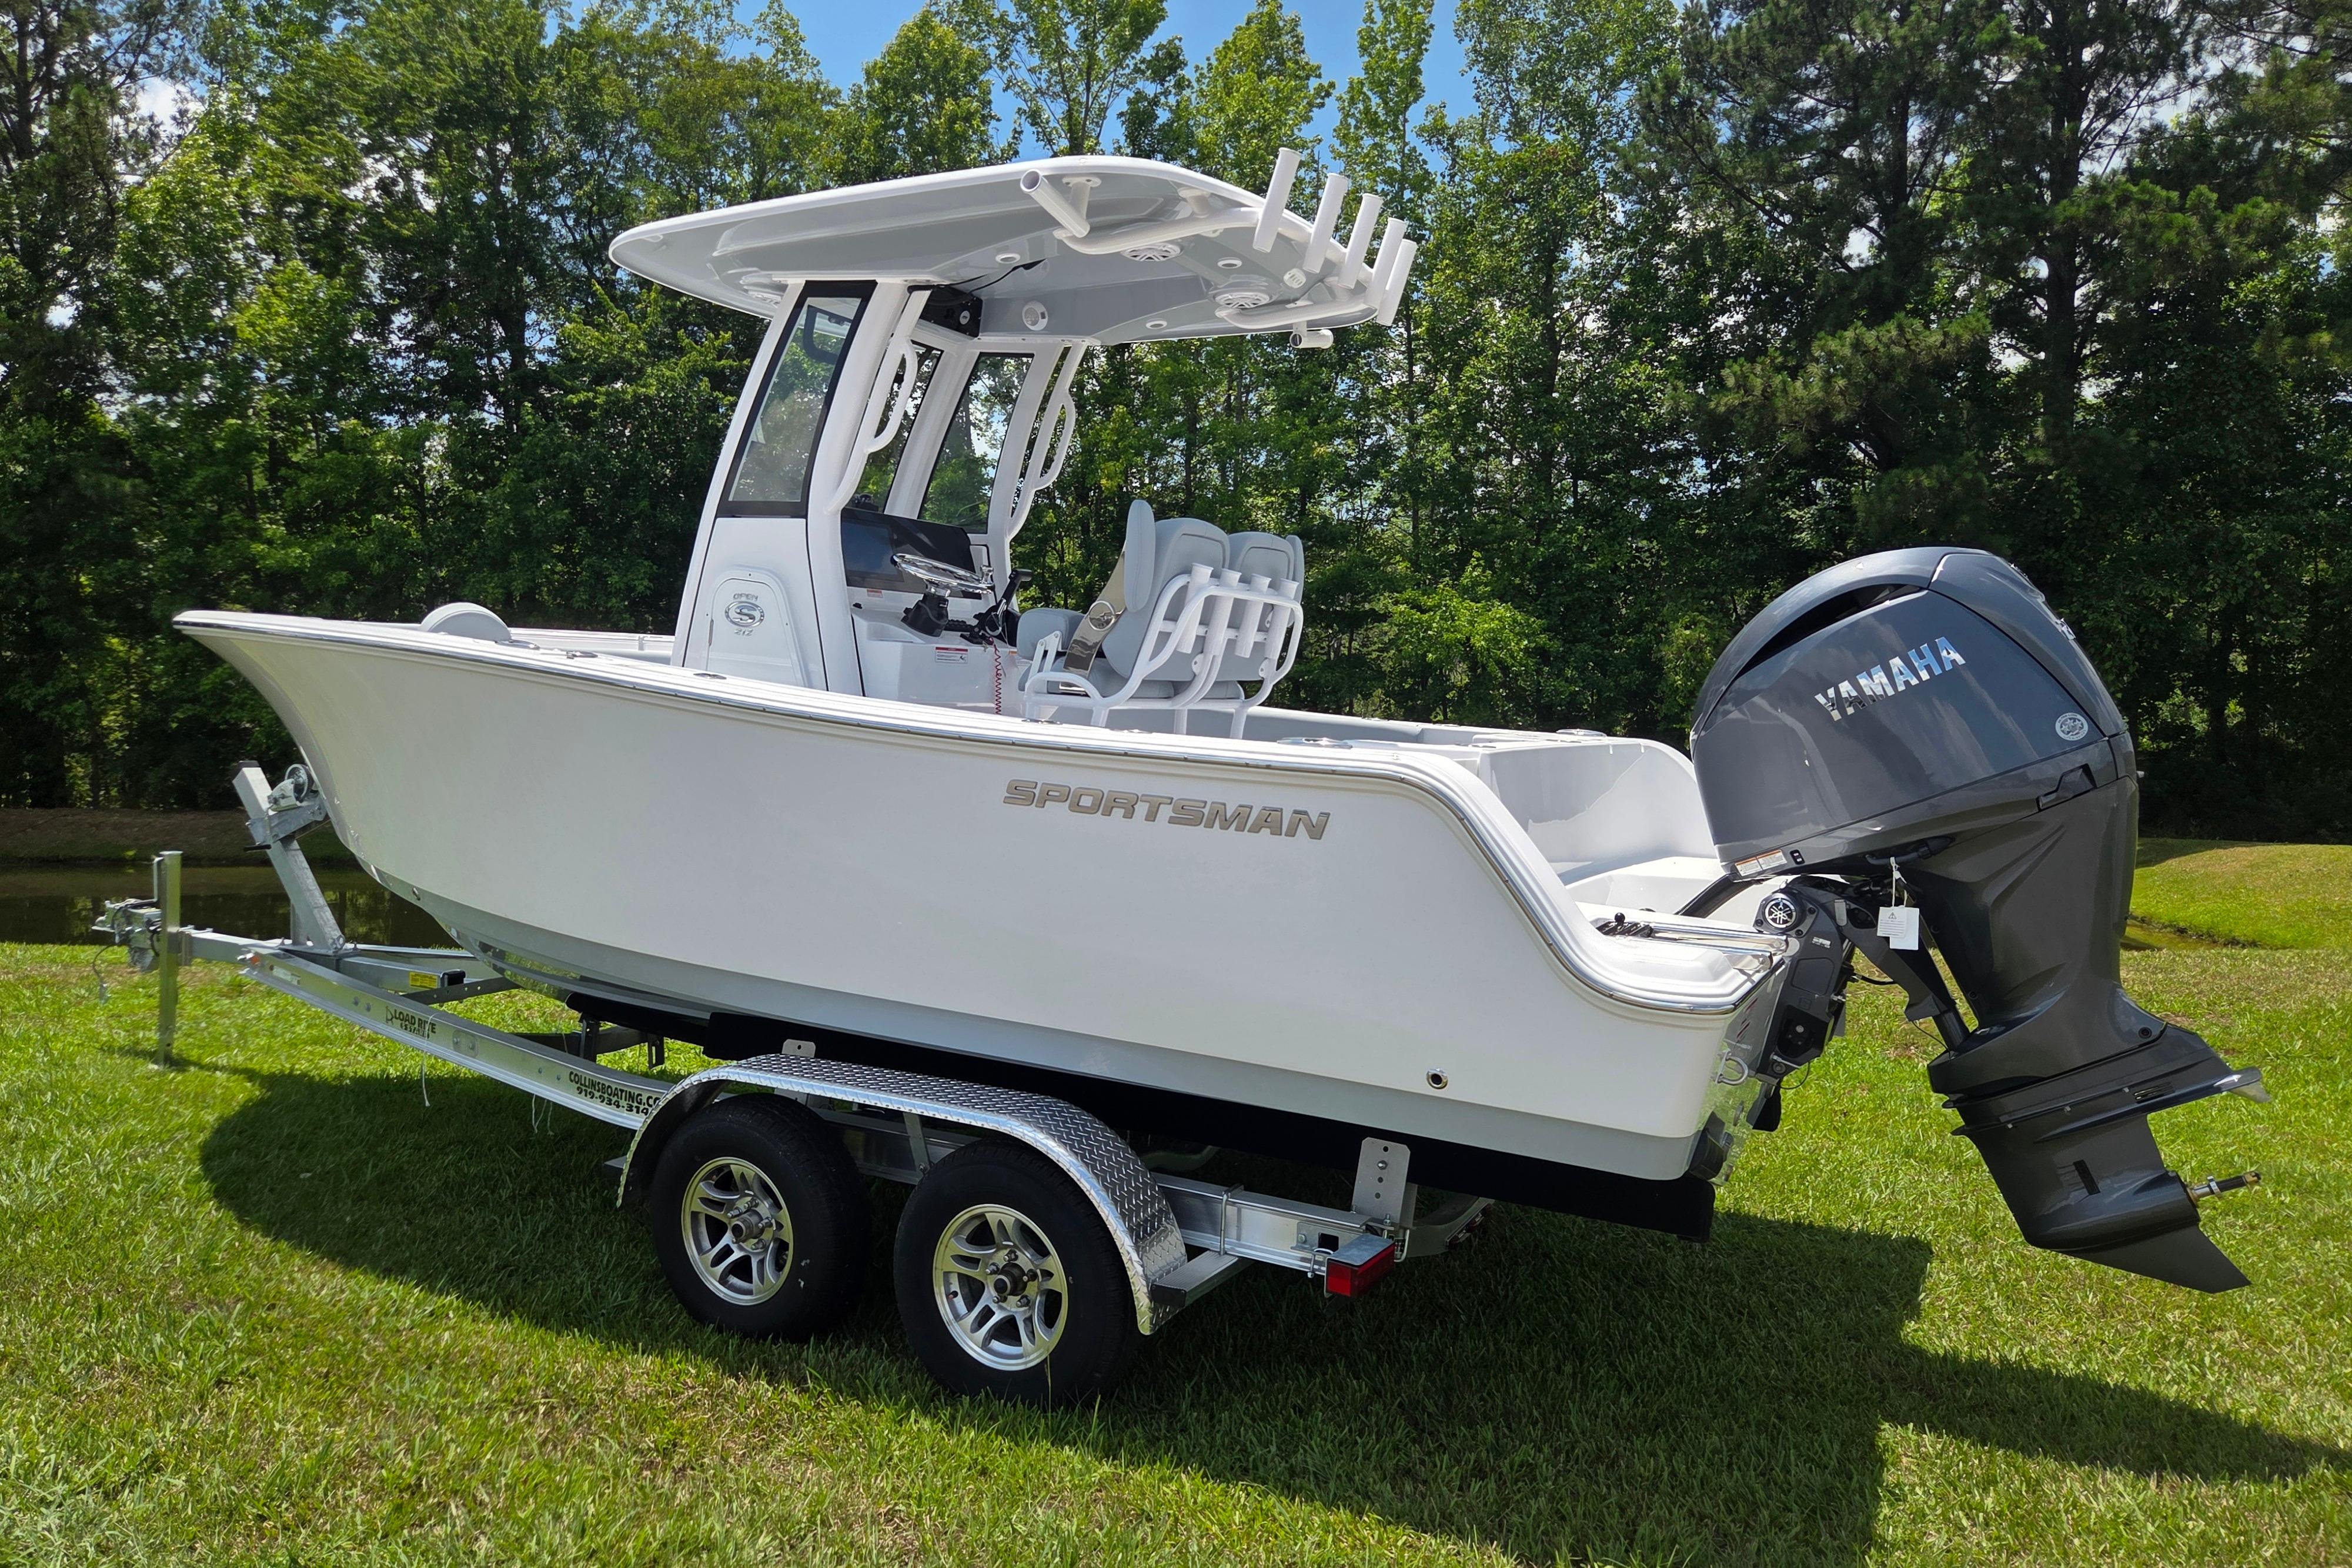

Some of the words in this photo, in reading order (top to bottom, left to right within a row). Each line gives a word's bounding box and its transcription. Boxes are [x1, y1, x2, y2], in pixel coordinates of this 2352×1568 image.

[733, 593, 758, 601] OPEN
[1815, 637, 1966, 721] YAMAHA
[1003, 779, 1331, 840] SPORTSMAN
[394, 1009, 416, 1026] LOAD
[417, 1017, 436, 1034] RITE
